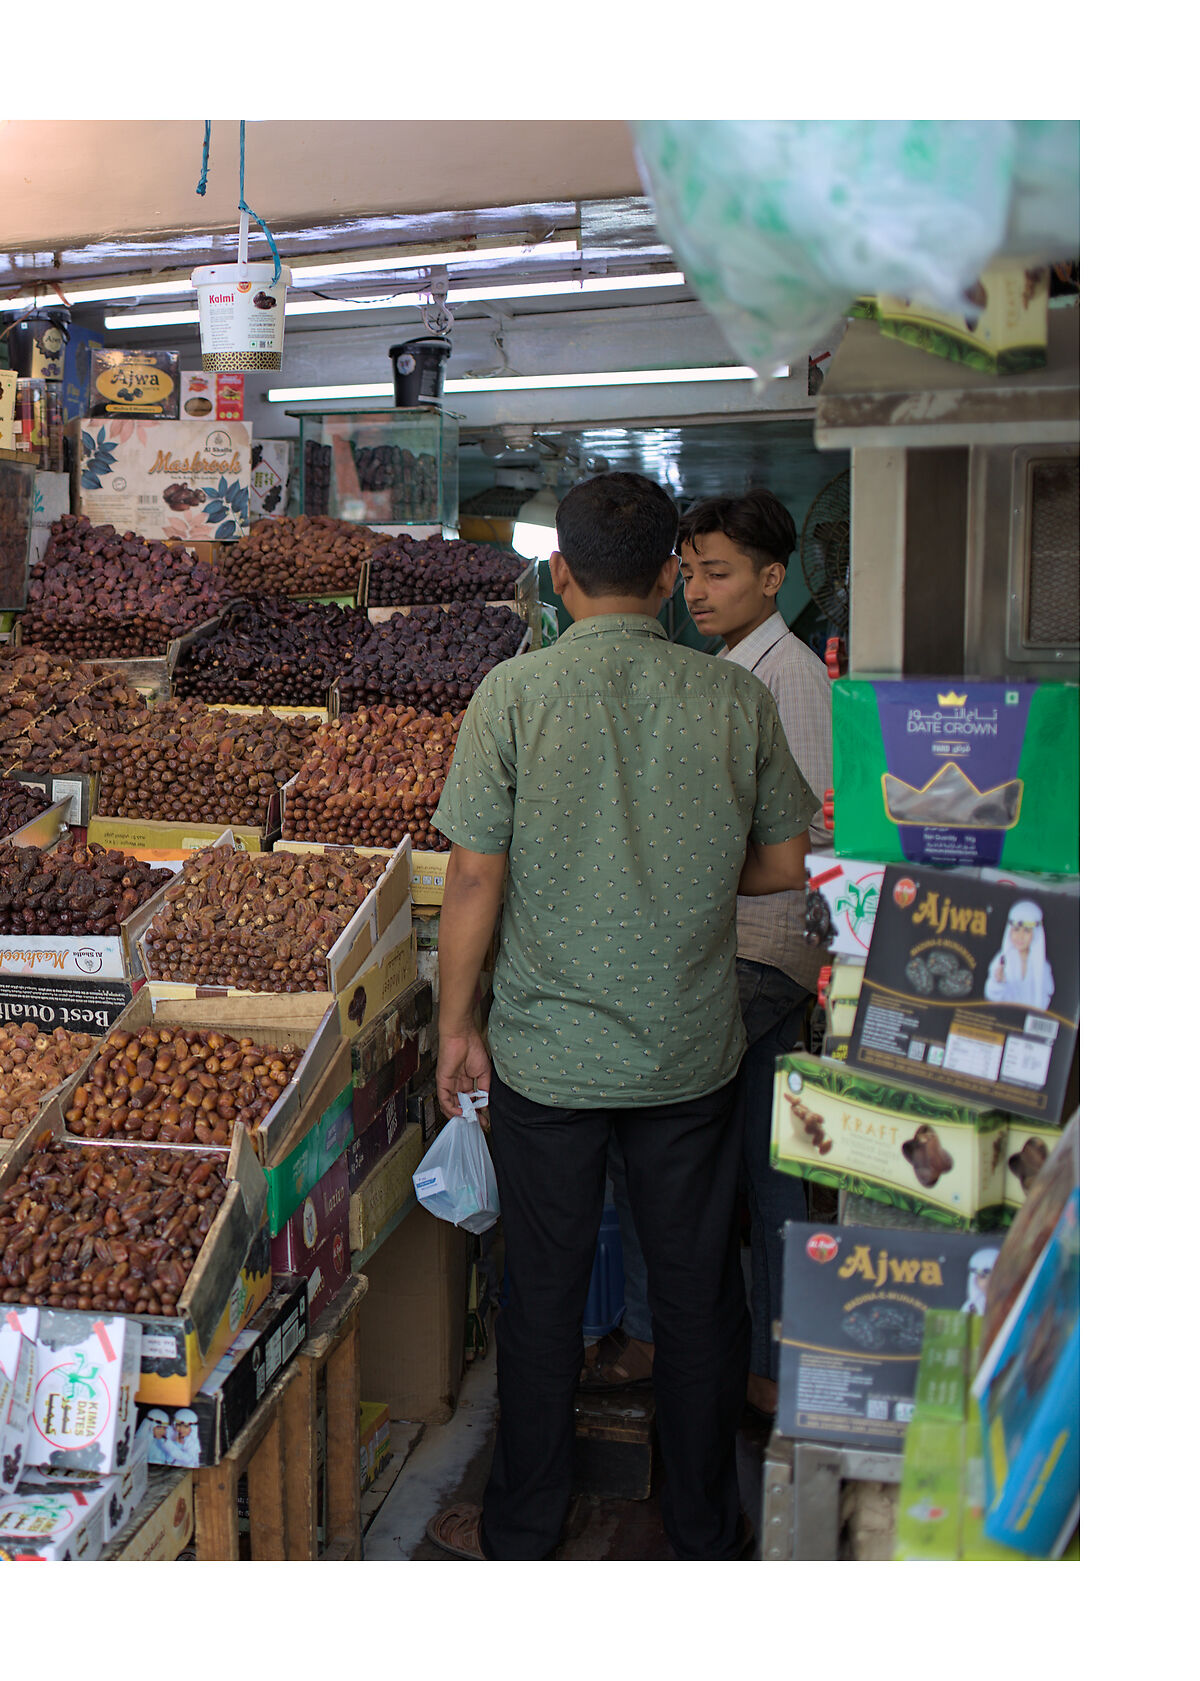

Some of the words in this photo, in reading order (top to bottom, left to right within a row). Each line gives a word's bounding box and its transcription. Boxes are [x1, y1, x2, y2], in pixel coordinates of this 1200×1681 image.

[209, 293, 234, 304] Kalmi
[111, 369, 159, 387] Ajwa
[148, 449, 242, 475] Mashrook
[907, 720, 942, 733] DATE
[943, 721, 998, 736] CROWN
[912, 891, 988, 936] Ajwa
[58, 1007, 110, 1027] Best
[841, 1111, 899, 1145] KRAFT
[838, 1245, 943, 1287] Ajwa
[75, 1400, 87, 1436] DATES
[86, 1402, 99, 1437] KIMIA
